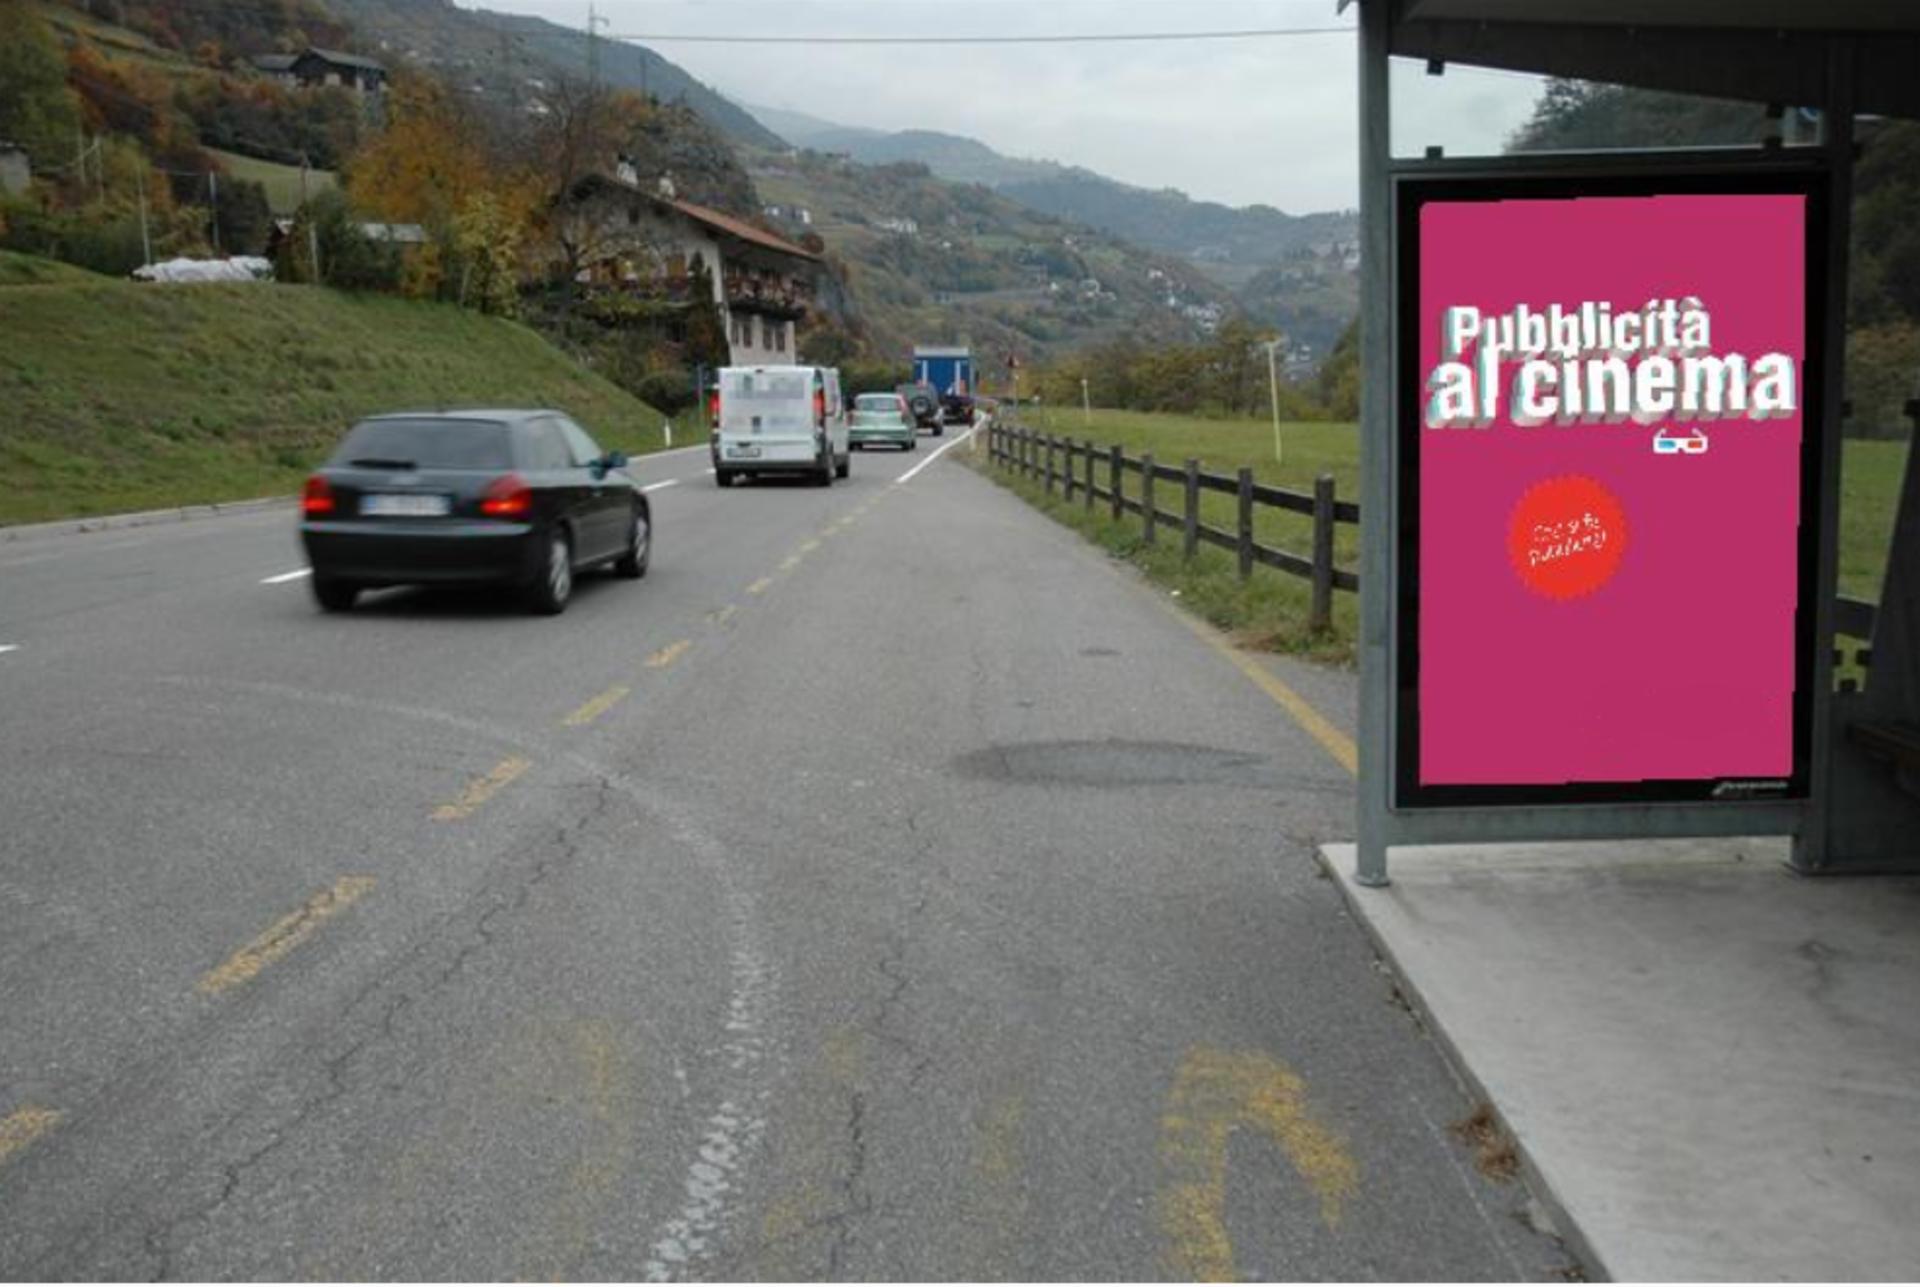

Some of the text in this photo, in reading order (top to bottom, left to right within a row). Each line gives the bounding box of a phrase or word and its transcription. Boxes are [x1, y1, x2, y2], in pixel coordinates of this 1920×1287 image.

[1445, 297, 1711, 356] Pubblicità
[1428, 345, 1796, 427] al cinema
